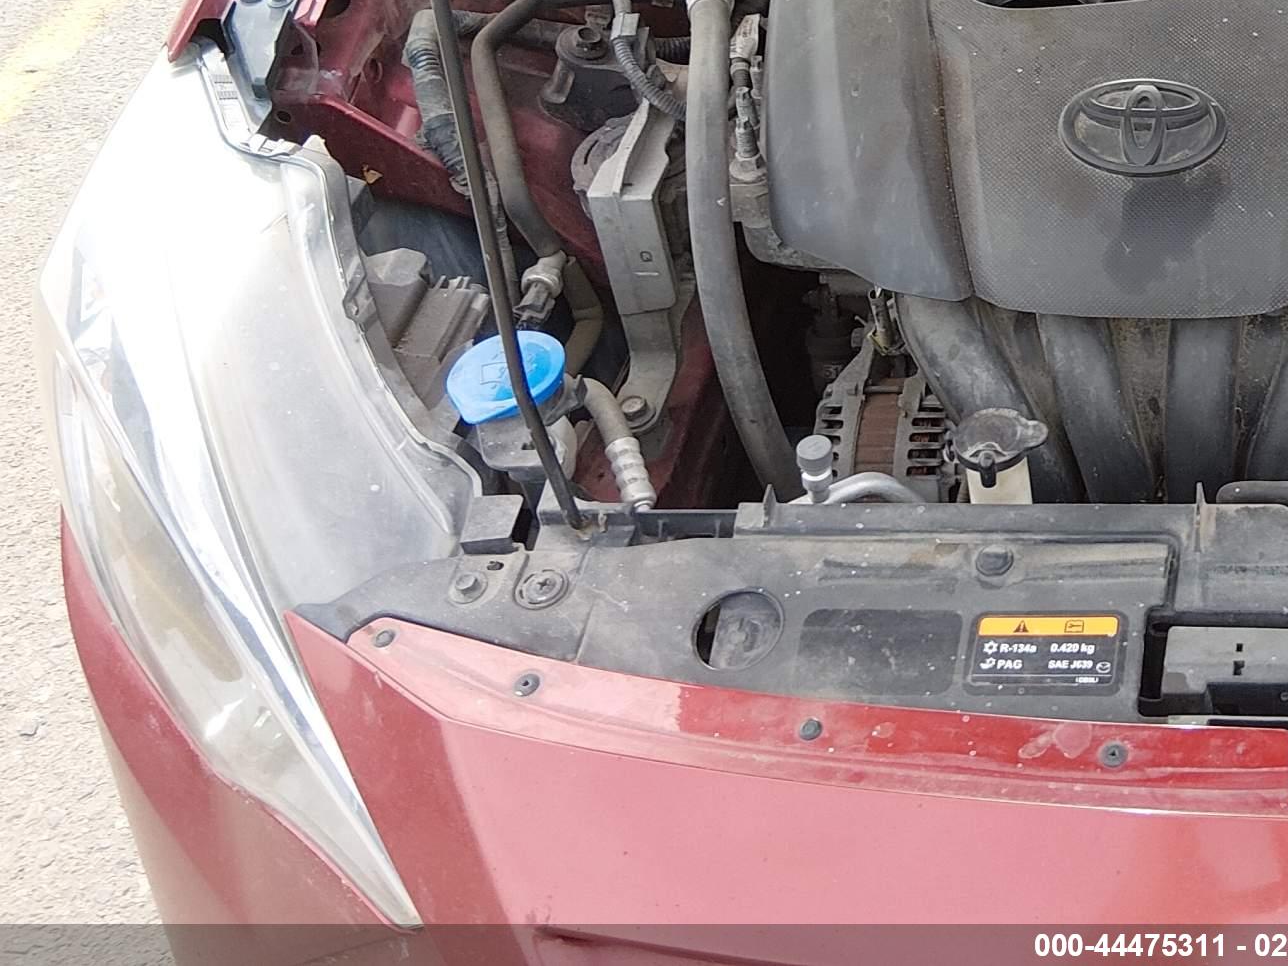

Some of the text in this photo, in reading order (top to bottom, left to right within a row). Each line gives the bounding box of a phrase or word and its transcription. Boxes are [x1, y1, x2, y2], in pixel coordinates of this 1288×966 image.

[1000, 643, 1095, 654] R-134a 0.420 kg
[997, 659, 1093, 670] PAG SAE J639
